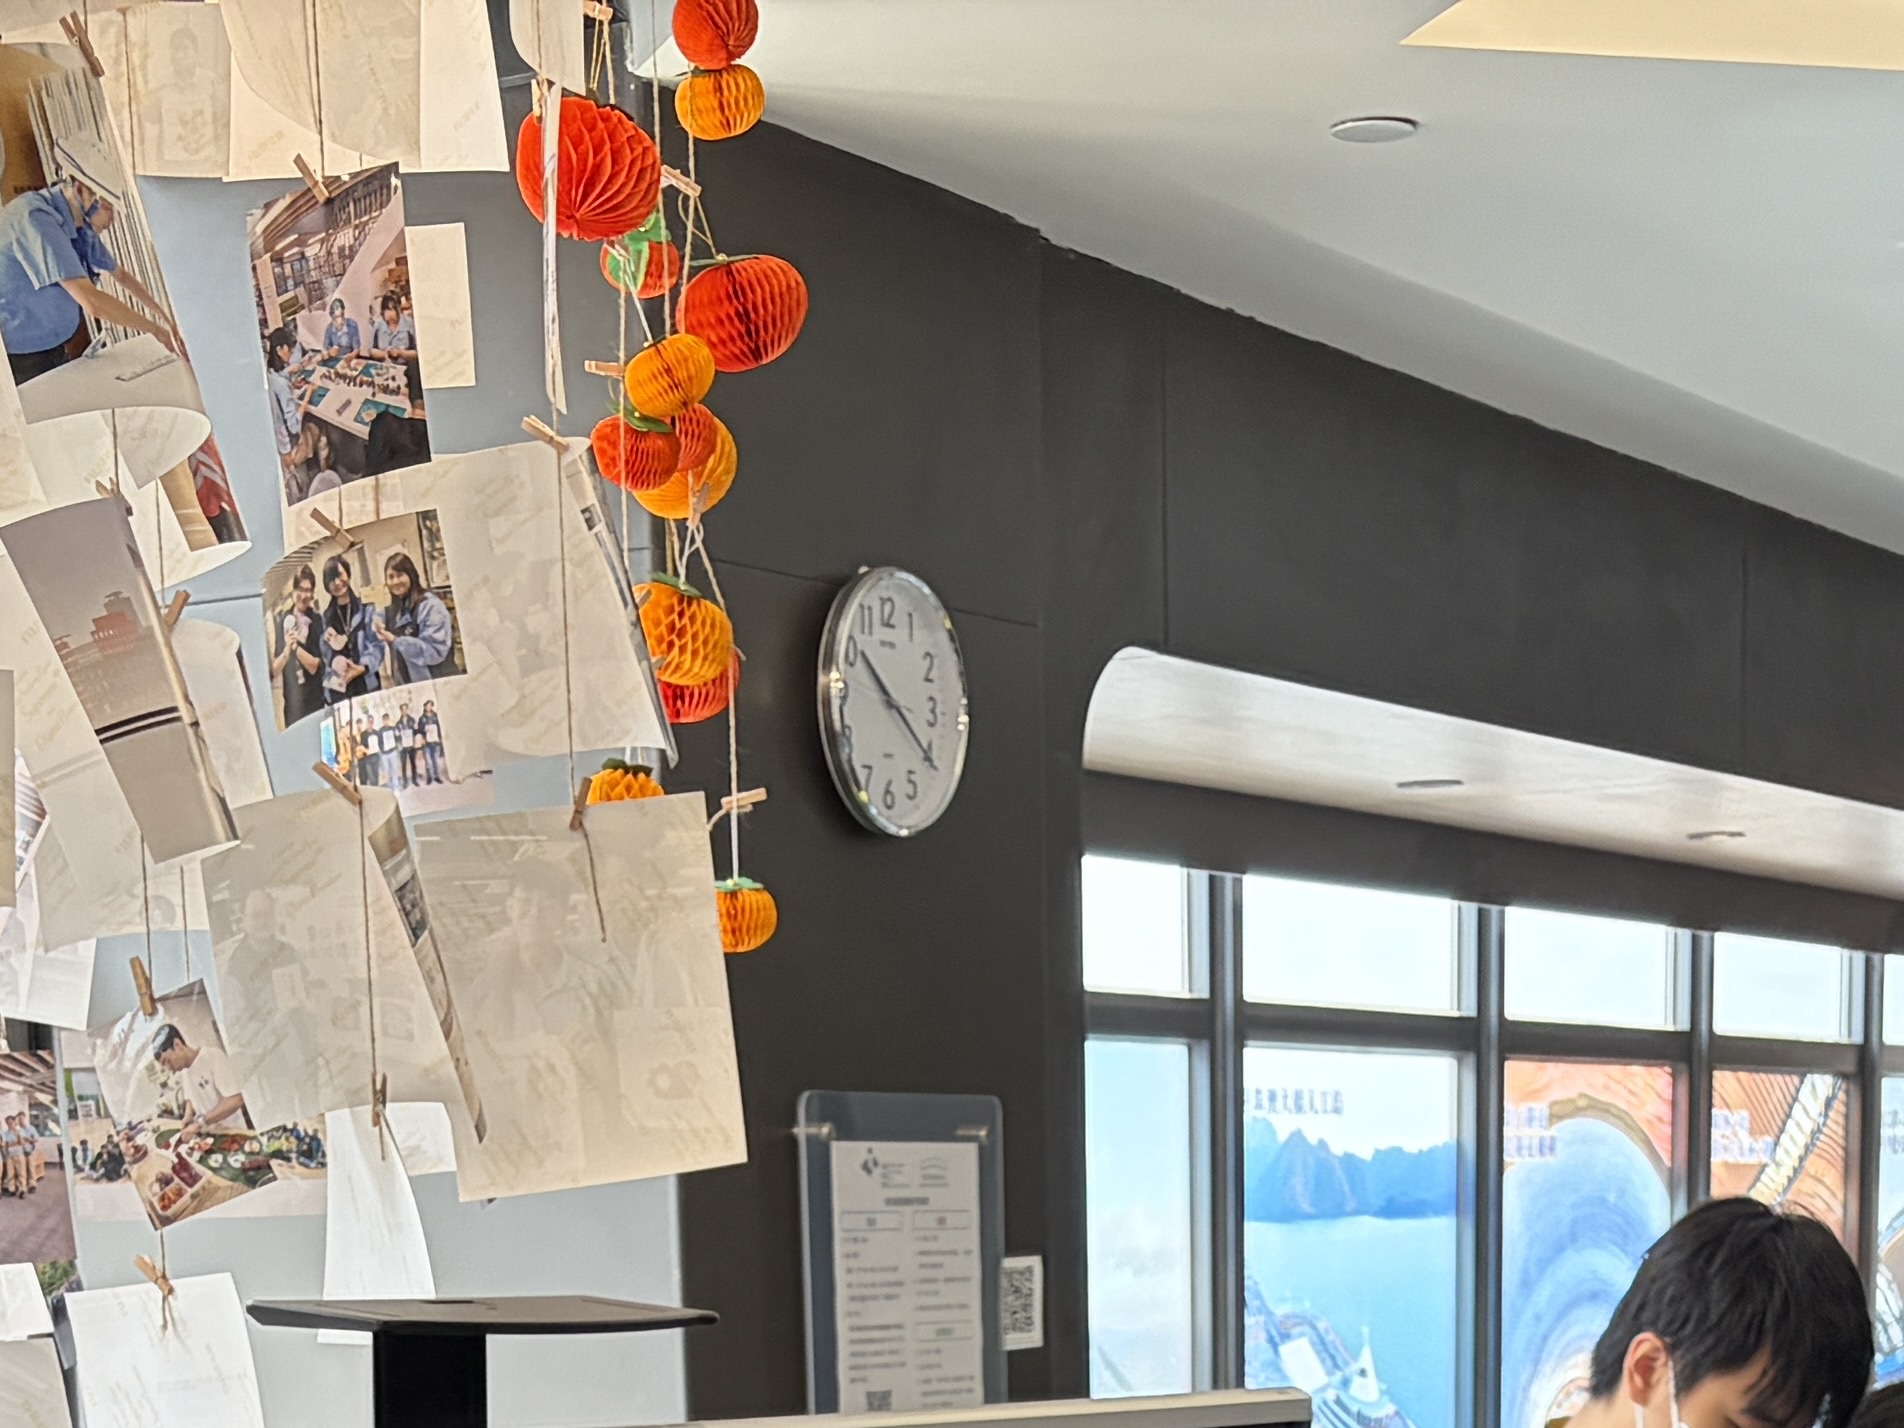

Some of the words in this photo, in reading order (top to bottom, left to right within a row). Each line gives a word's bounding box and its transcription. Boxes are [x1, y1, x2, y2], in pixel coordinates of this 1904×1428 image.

[859, 603, 873, 637] 11
[879, 596, 896, 629] 12
[907, 612, 914, 642] 1
[846, 634, 858, 667] 0
[922, 651, 935, 683] 2
[925, 696, 938, 728] 3
[861, 764, 873, 794] 7
[883, 778, 895, 810] 6
[905, 770, 918, 801] 5
